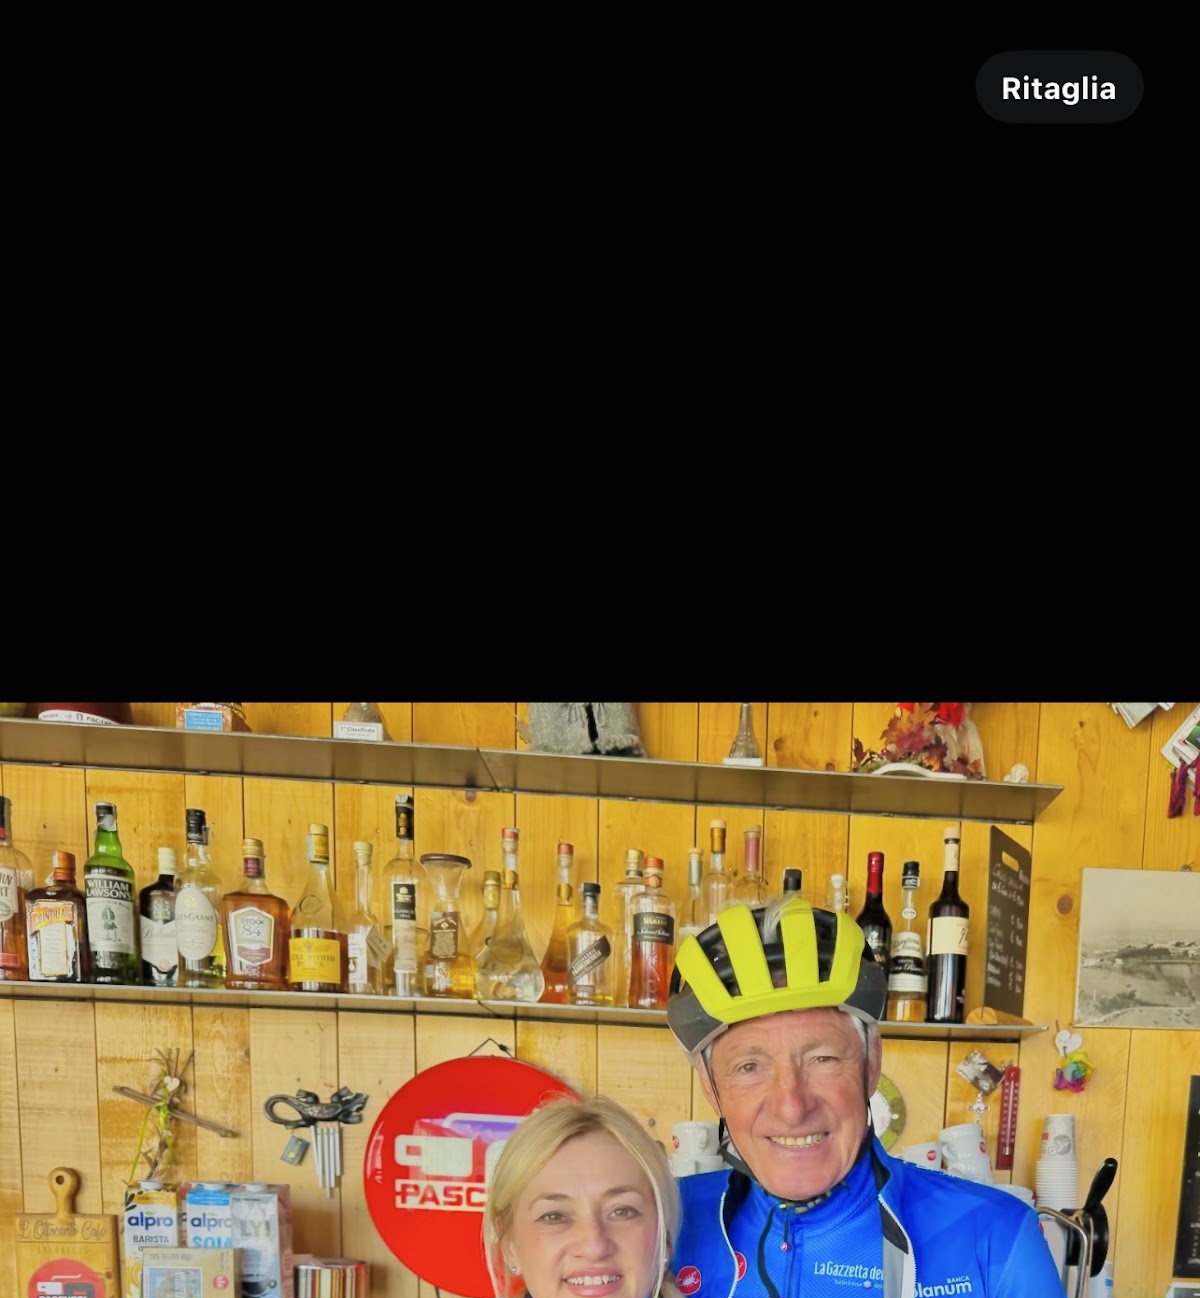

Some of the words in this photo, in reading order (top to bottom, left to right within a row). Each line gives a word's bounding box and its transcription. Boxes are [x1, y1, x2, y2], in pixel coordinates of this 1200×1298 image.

[86, 879, 130, 891] WILLIAM
[86, 888, 132, 900] LAWSON'S
[240, 917, 265, 926] STOCK
[241, 924, 263, 938] 84
[400, 1183, 486, 1208] PASC
[127, 1211, 174, 1231] alpro
[240, 1220, 271, 1238] LY!
[132, 1235, 170, 1244] BARISTA
[826, 1260, 868, 1280] Gazzetta
[947, 1275, 971, 1284] BANCA
[914, 1280, 973, 1298] olanum
